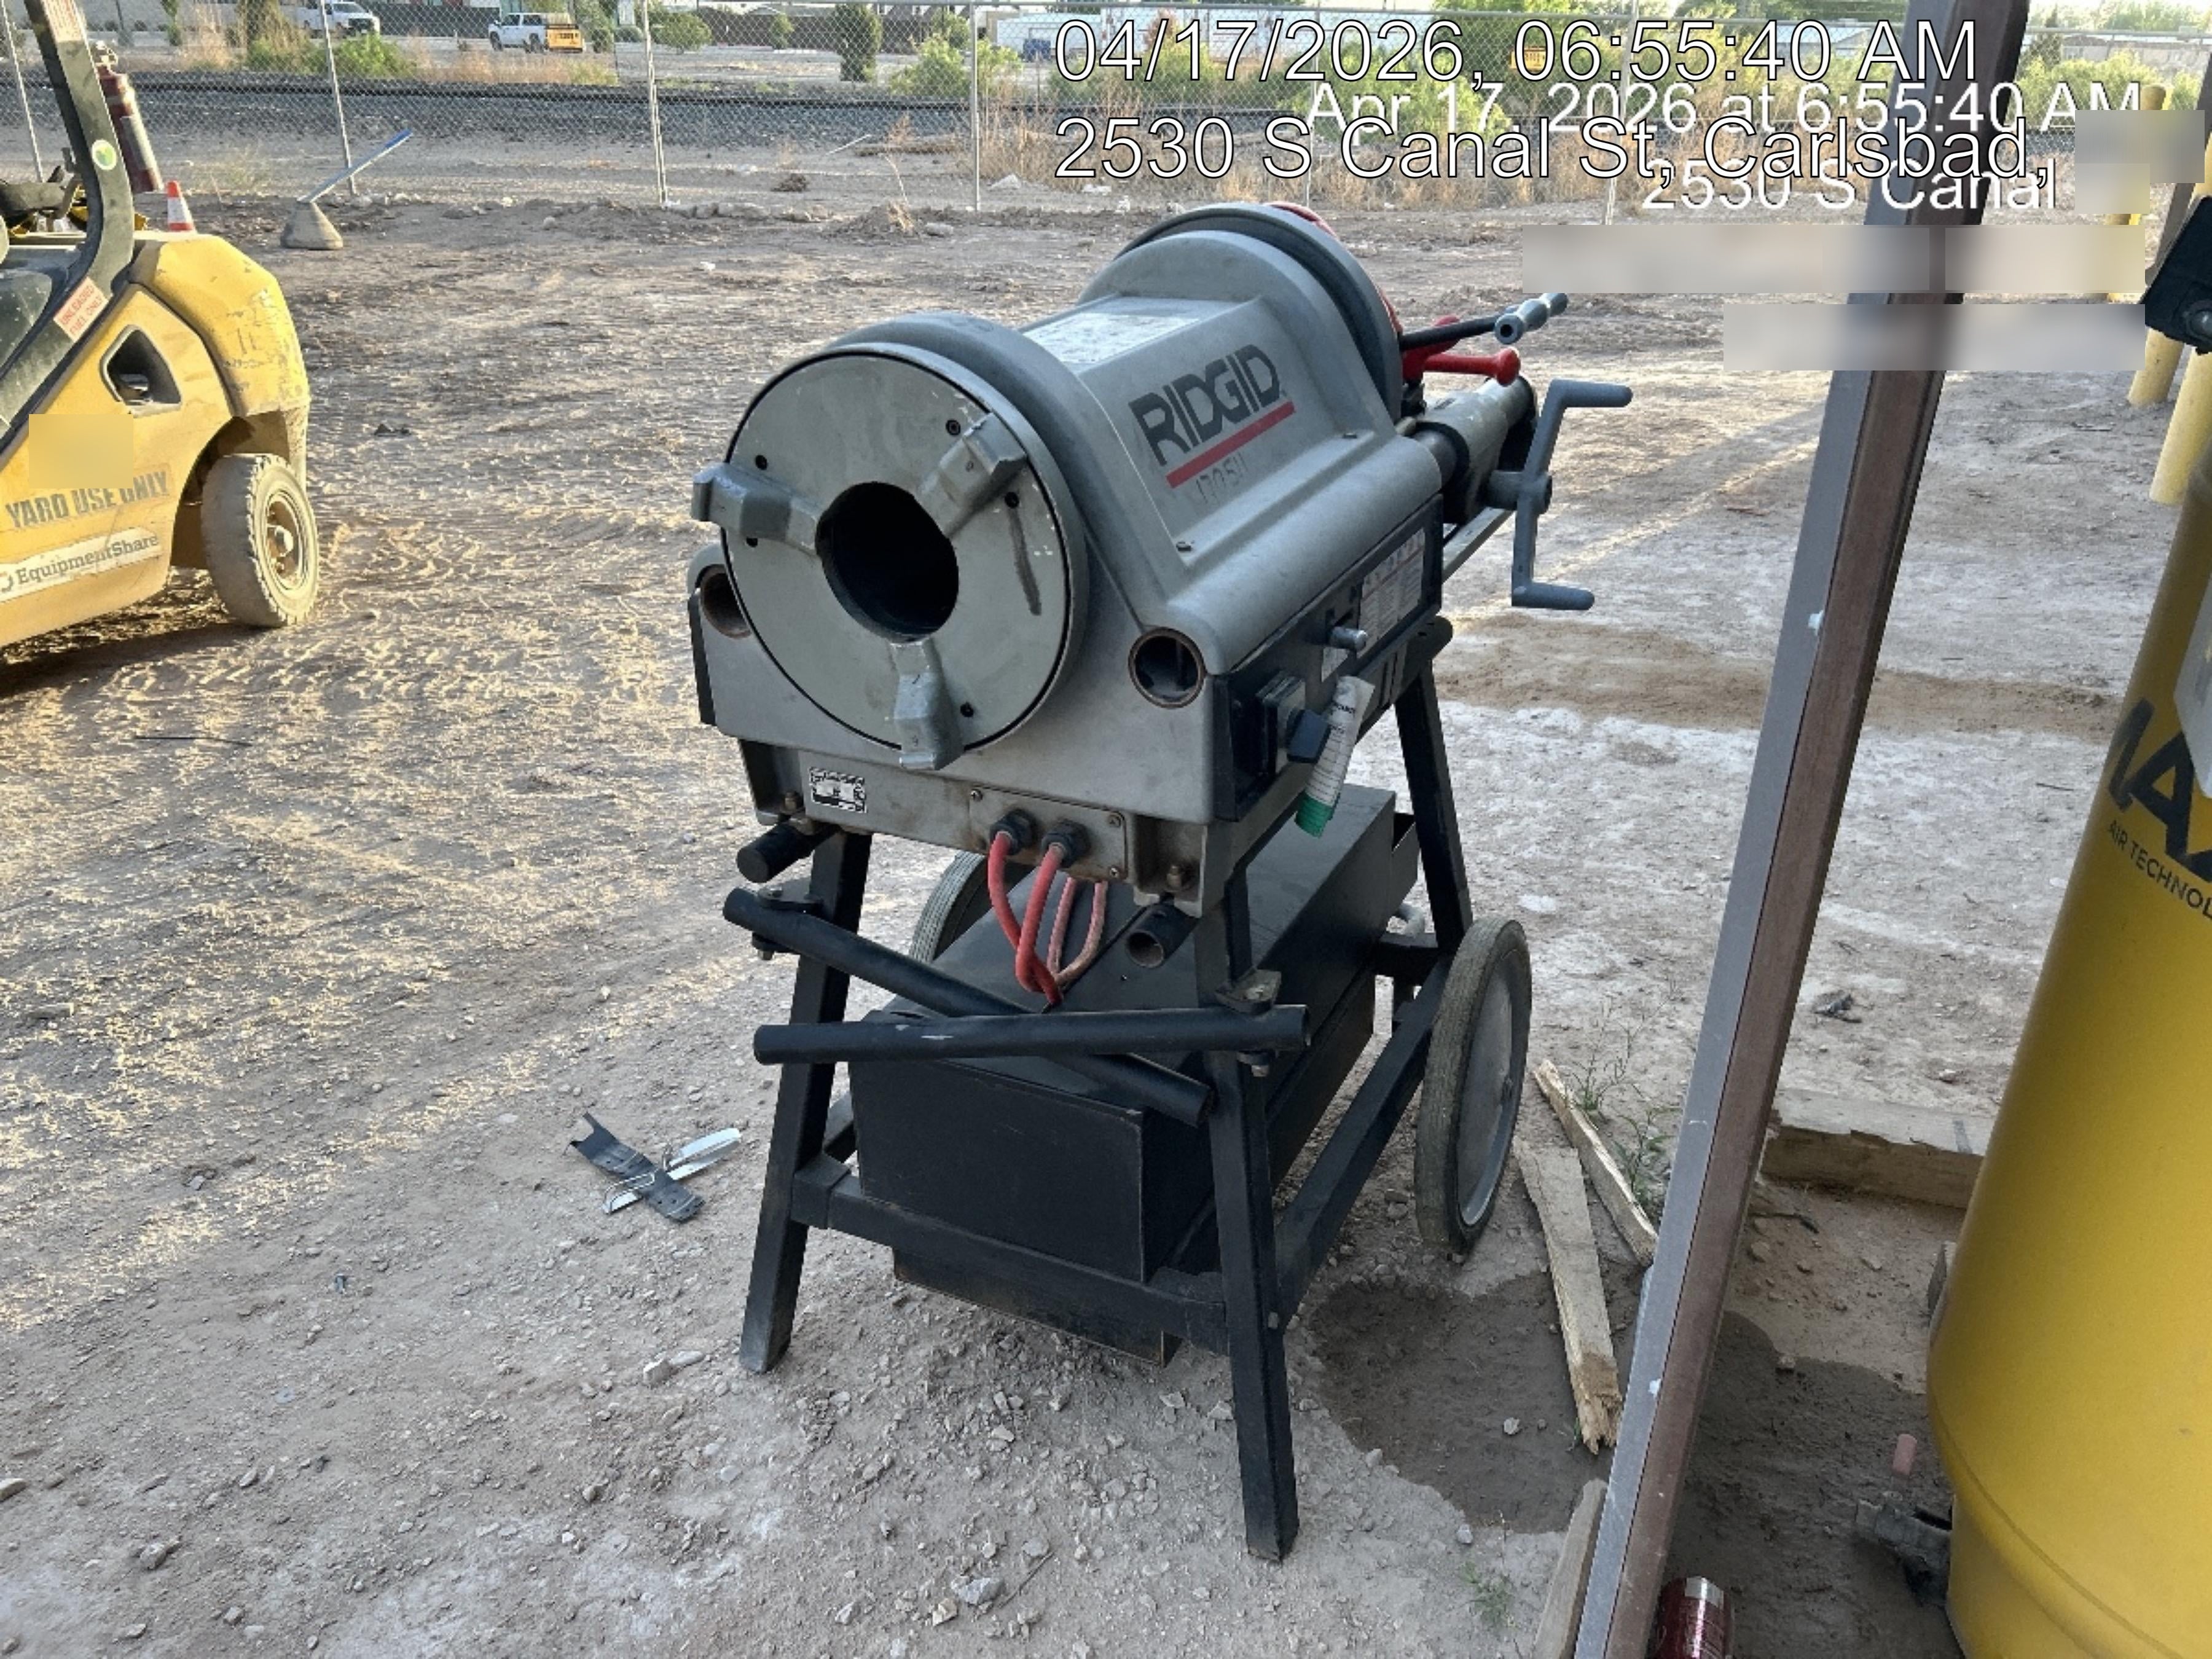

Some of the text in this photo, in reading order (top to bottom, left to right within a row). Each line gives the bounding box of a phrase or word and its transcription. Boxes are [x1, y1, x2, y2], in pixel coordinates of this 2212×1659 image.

[1128, 344, 1280, 466] RIDGID
[5, 493, 69, 528] YARD
[71, 488, 117, 515] USE
[15, 534, 159, 585] EquipmentShare
[2109, 819, 2128, 852] AIR
